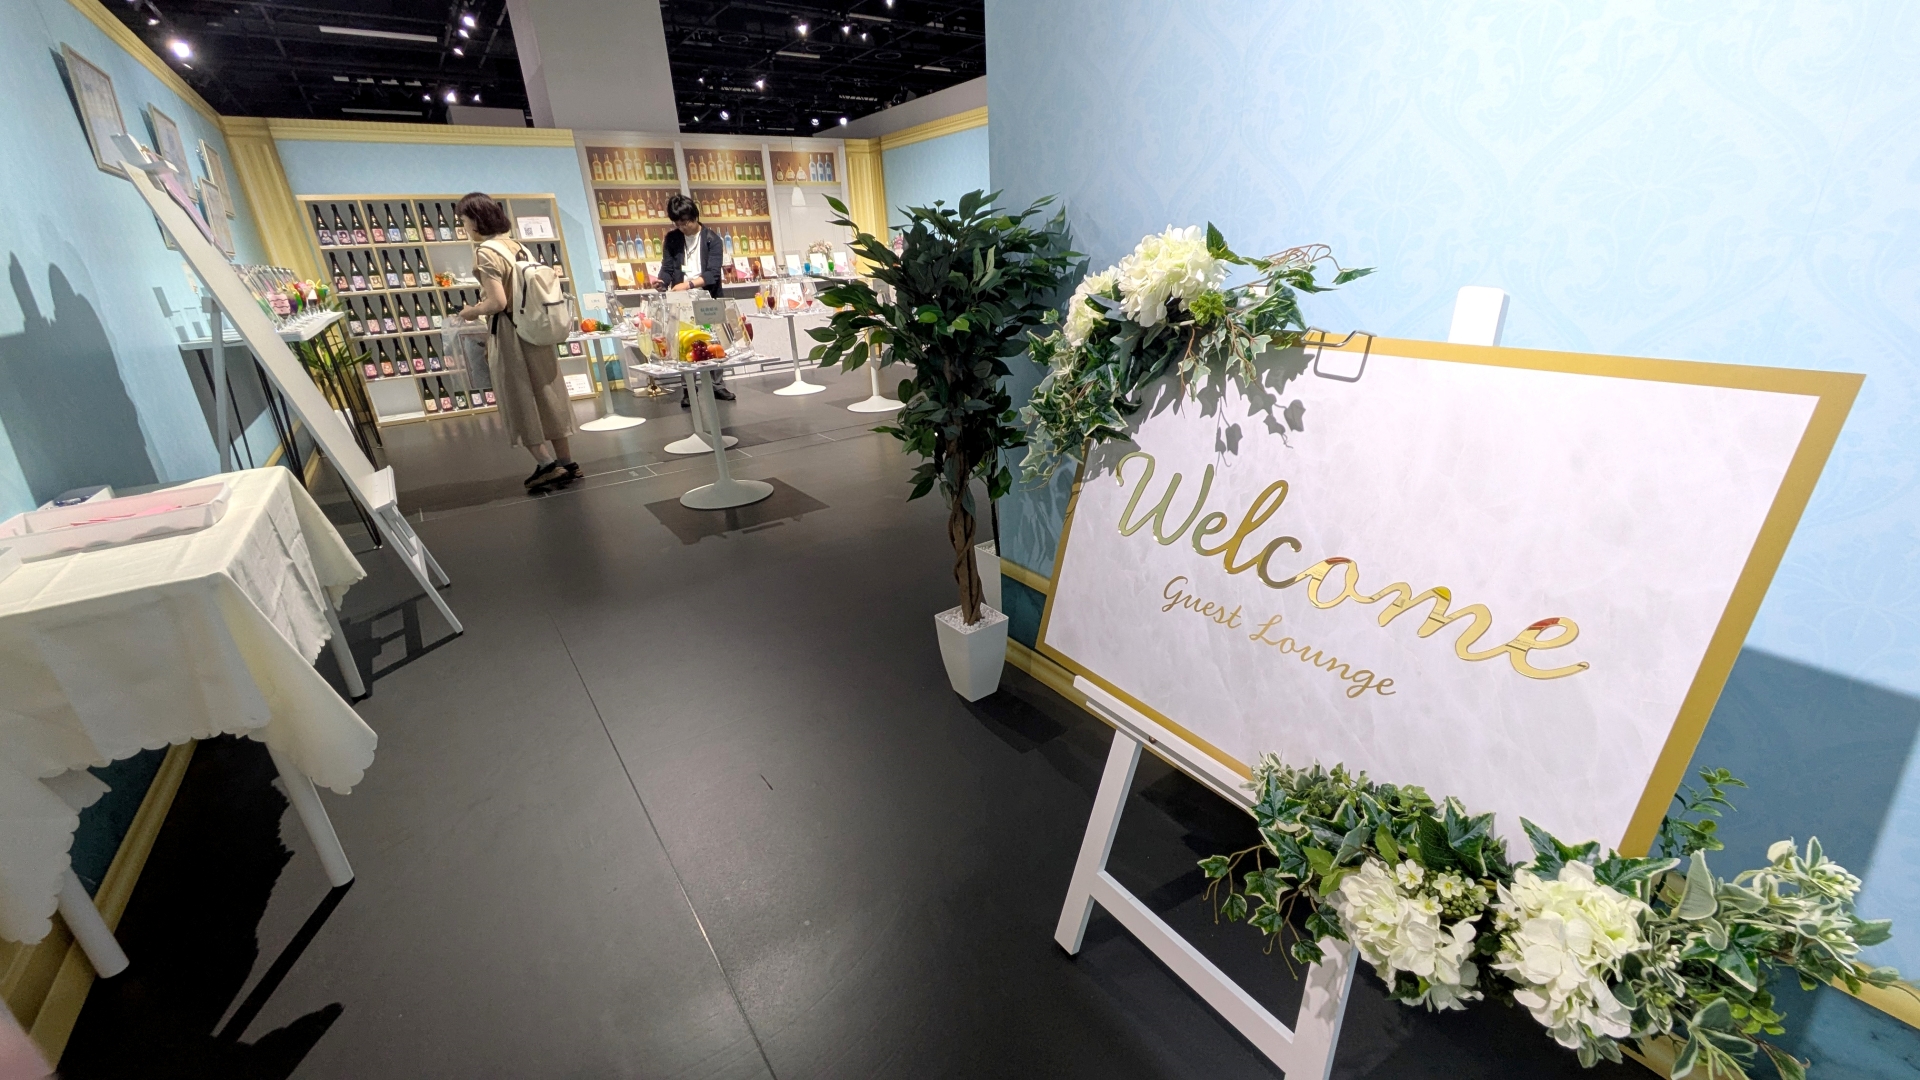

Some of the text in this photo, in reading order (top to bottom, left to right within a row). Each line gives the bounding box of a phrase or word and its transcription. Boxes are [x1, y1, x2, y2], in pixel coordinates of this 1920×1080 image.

[1116, 452, 1590, 680] Welcome
[1161, 575, 1396, 698] Guest Lounge
